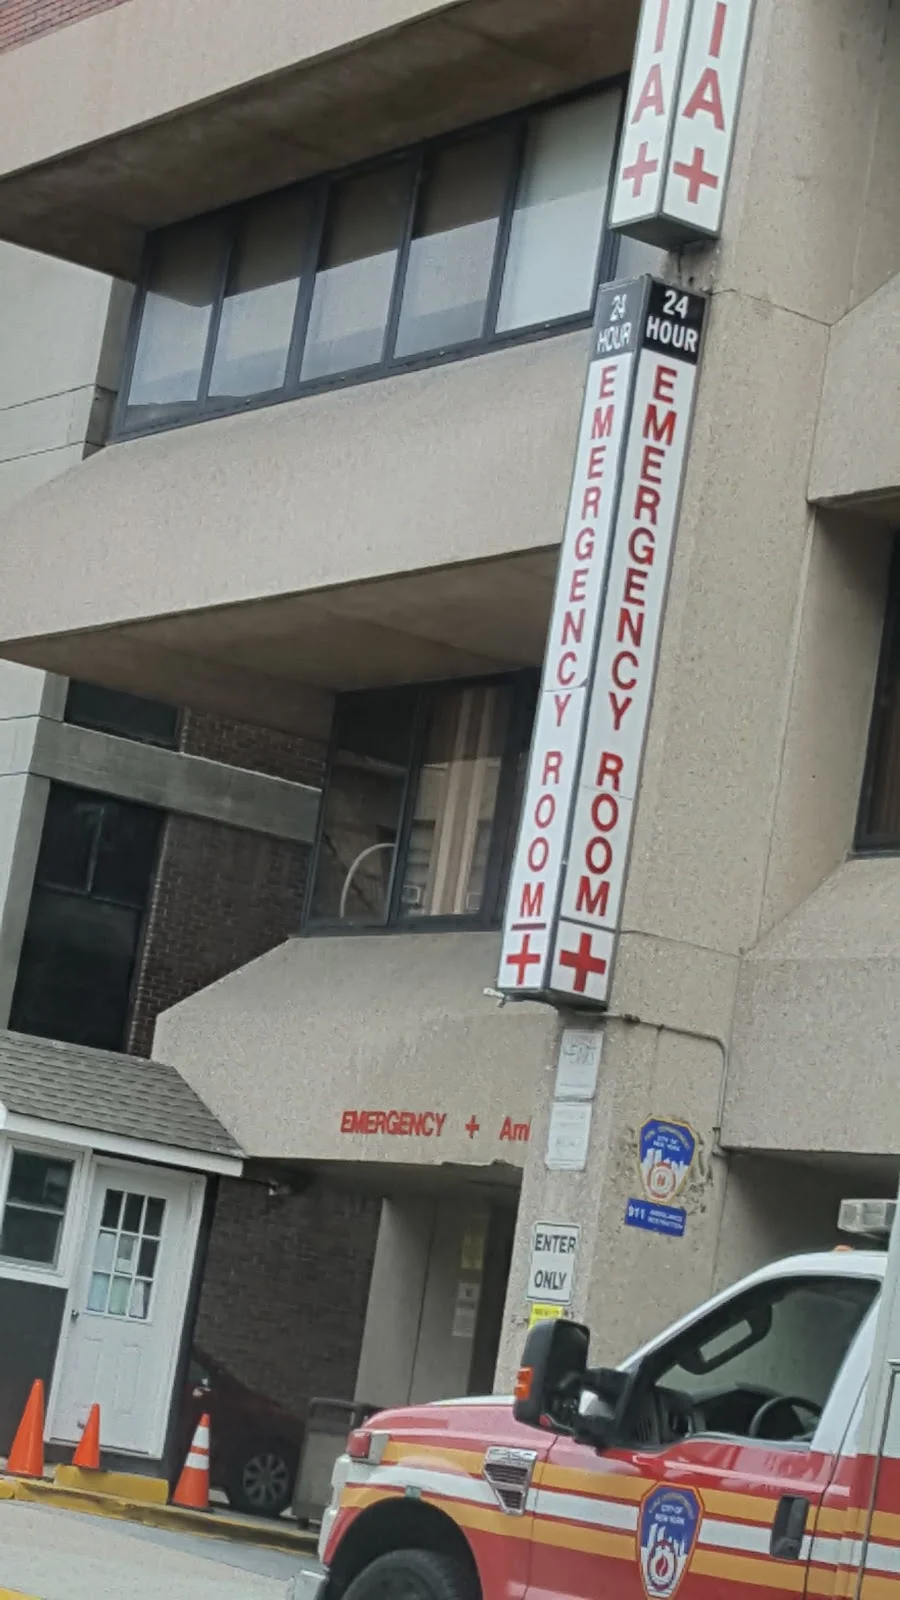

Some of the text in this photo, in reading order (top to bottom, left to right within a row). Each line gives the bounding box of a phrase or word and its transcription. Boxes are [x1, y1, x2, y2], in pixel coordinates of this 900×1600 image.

[610, 293, 628, 321] 24
[663, 290, 689, 319] 24
[597, 322, 632, 353] HOUR
[646, 315, 698, 352] HOUR
[520, 365, 618, 917] EMERGENCY ROOM
[575, 364, 677, 917] EMERGENCY ROOM
[340, 1109, 447, 1136] EMERGENCY
[628, 1204, 646, 1220] 911
[534, 1234, 577, 1254] ENTER
[534, 1270, 567, 1290] ONLY
